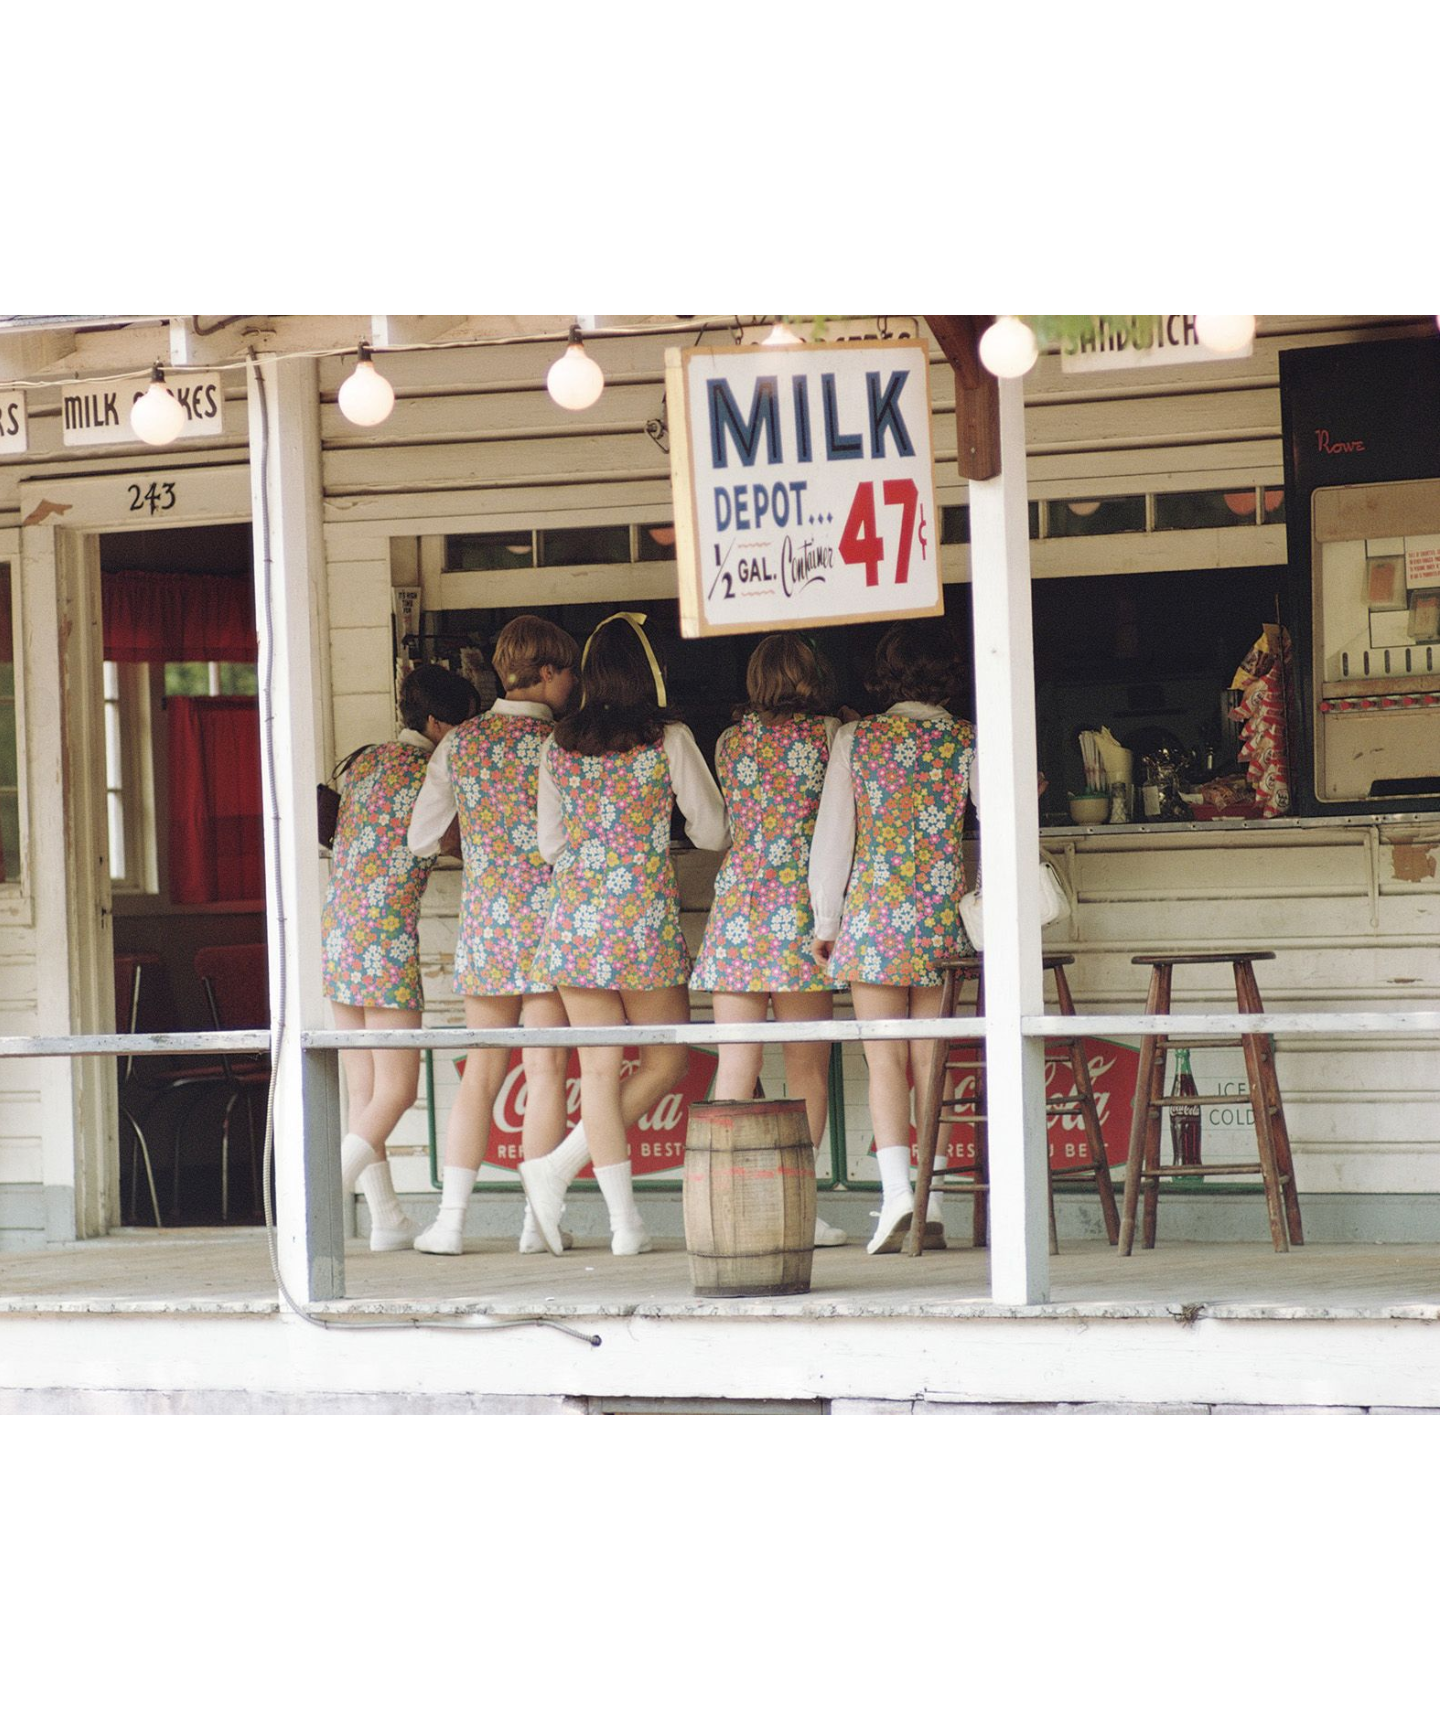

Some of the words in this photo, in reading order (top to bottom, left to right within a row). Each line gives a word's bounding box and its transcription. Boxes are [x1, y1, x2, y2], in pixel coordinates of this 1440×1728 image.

[64, 391, 120, 430] MILK
[133, 384, 218, 421] KES
[706, 370, 916, 469] MILK
[127, 481, 177, 516] 243
[738, 556, 778, 584] GAL.
[780, 535, 835, 599] Container
[641, 1142, 686, 1157] BEST
